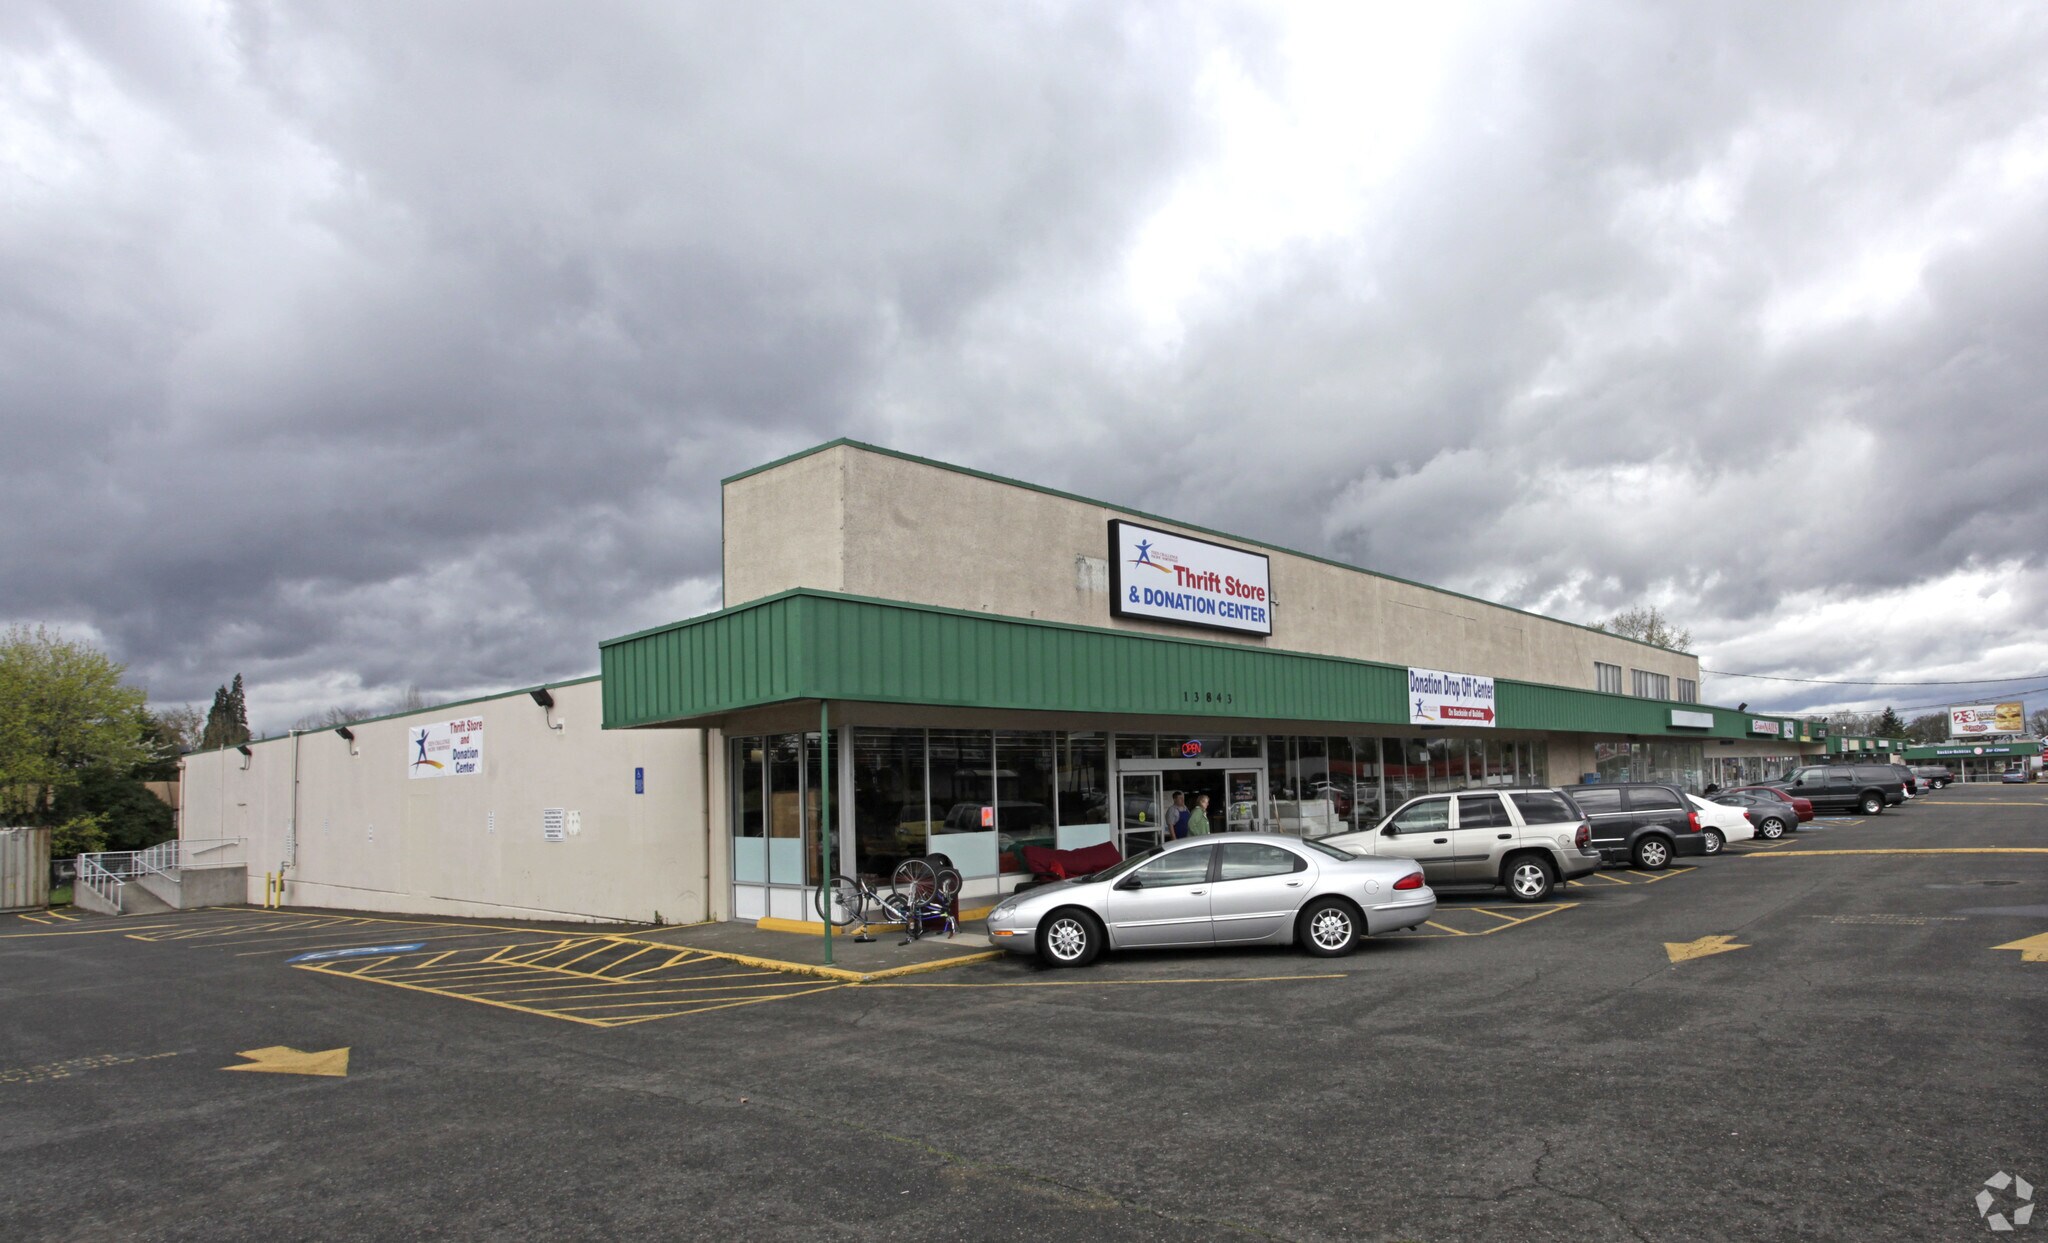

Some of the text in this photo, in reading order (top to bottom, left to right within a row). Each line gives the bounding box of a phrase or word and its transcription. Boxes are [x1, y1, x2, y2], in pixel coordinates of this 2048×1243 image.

[1173, 564, 1265, 601] Thrift Store
[1129, 585, 1266, 623] & DONATION CENTER
[1410, 670, 1493, 701] Donation Drop Off Center
[1184, 691, 1232, 704] 13843
[1448, 707, 1454, 716] On
[1454, 708, 1468, 717] Backside
[1473, 709, 1484, 720] Building
[450, 719, 482, 734] Thrift Store
[460, 733, 469, 744] and
[453, 747, 478, 760] Donation
[1182, 743, 1201, 754] OPEN
[456, 762, 475, 774] Center
